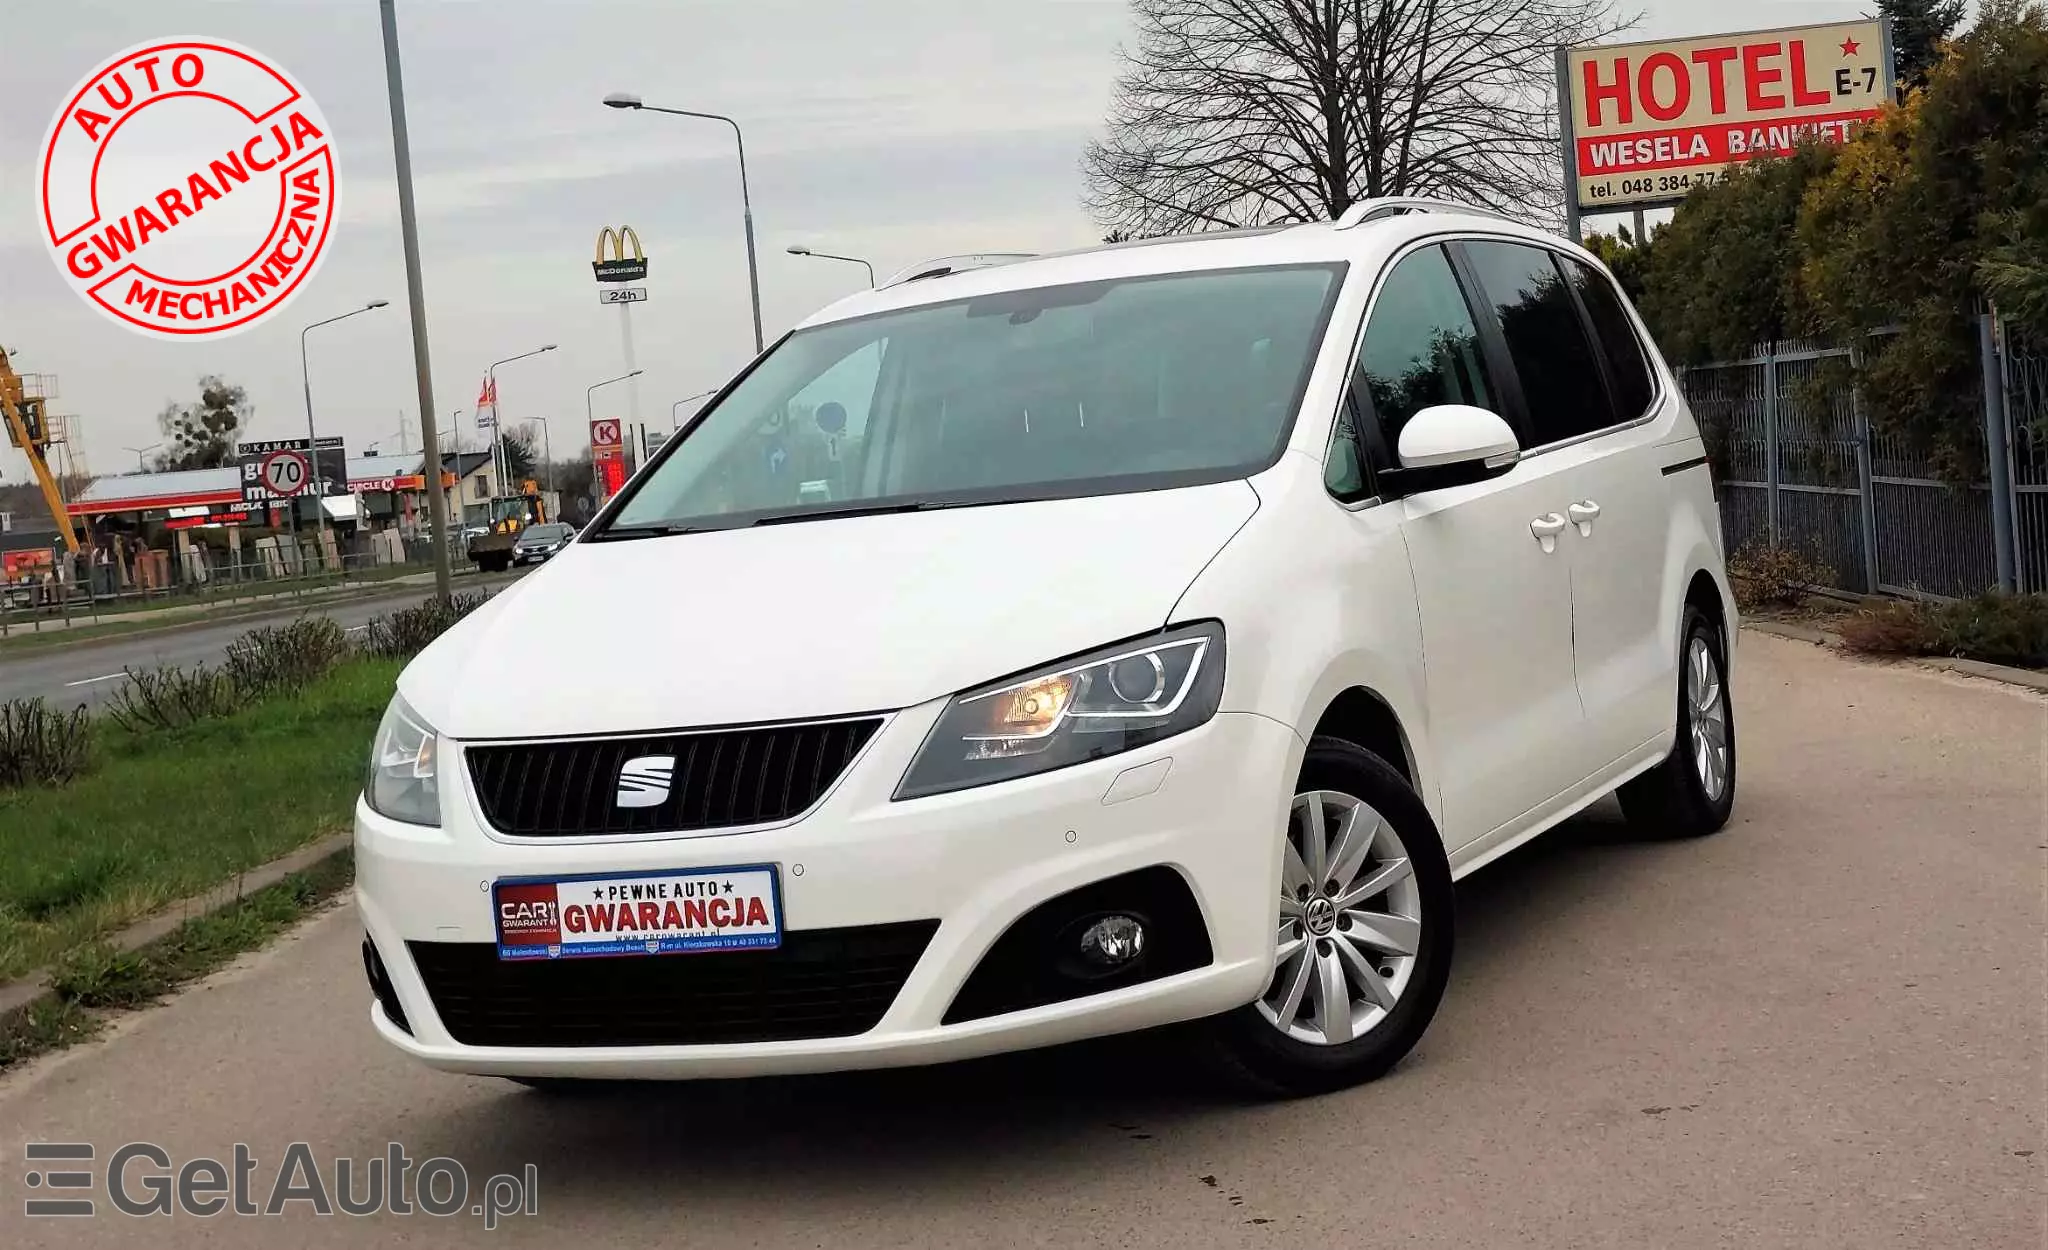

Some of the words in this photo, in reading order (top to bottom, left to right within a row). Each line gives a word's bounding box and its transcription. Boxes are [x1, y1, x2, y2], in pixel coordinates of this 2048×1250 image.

[1582, 39, 1832, 128] HOTEL
[1834, 66, 1877, 96] E-7
[1589, 133, 1711, 168] WESELA
[1589, 181, 1617, 198] tel.
[1621, 177, 1653, 195] 048
[1658, 174, 1690, 192] 384
[597, 266, 645, 276] McDonald's
[609, 290, 637, 301] 24h
[271, 462, 301, 483] 70
[608, 883, 667, 900] PEWNE
[674, 881, 718, 897] AUTO
[501, 902, 548, 919] CAR
[563, 896, 769, 933] GWARANCJA
[502, 919, 549, 928] GWARANT
